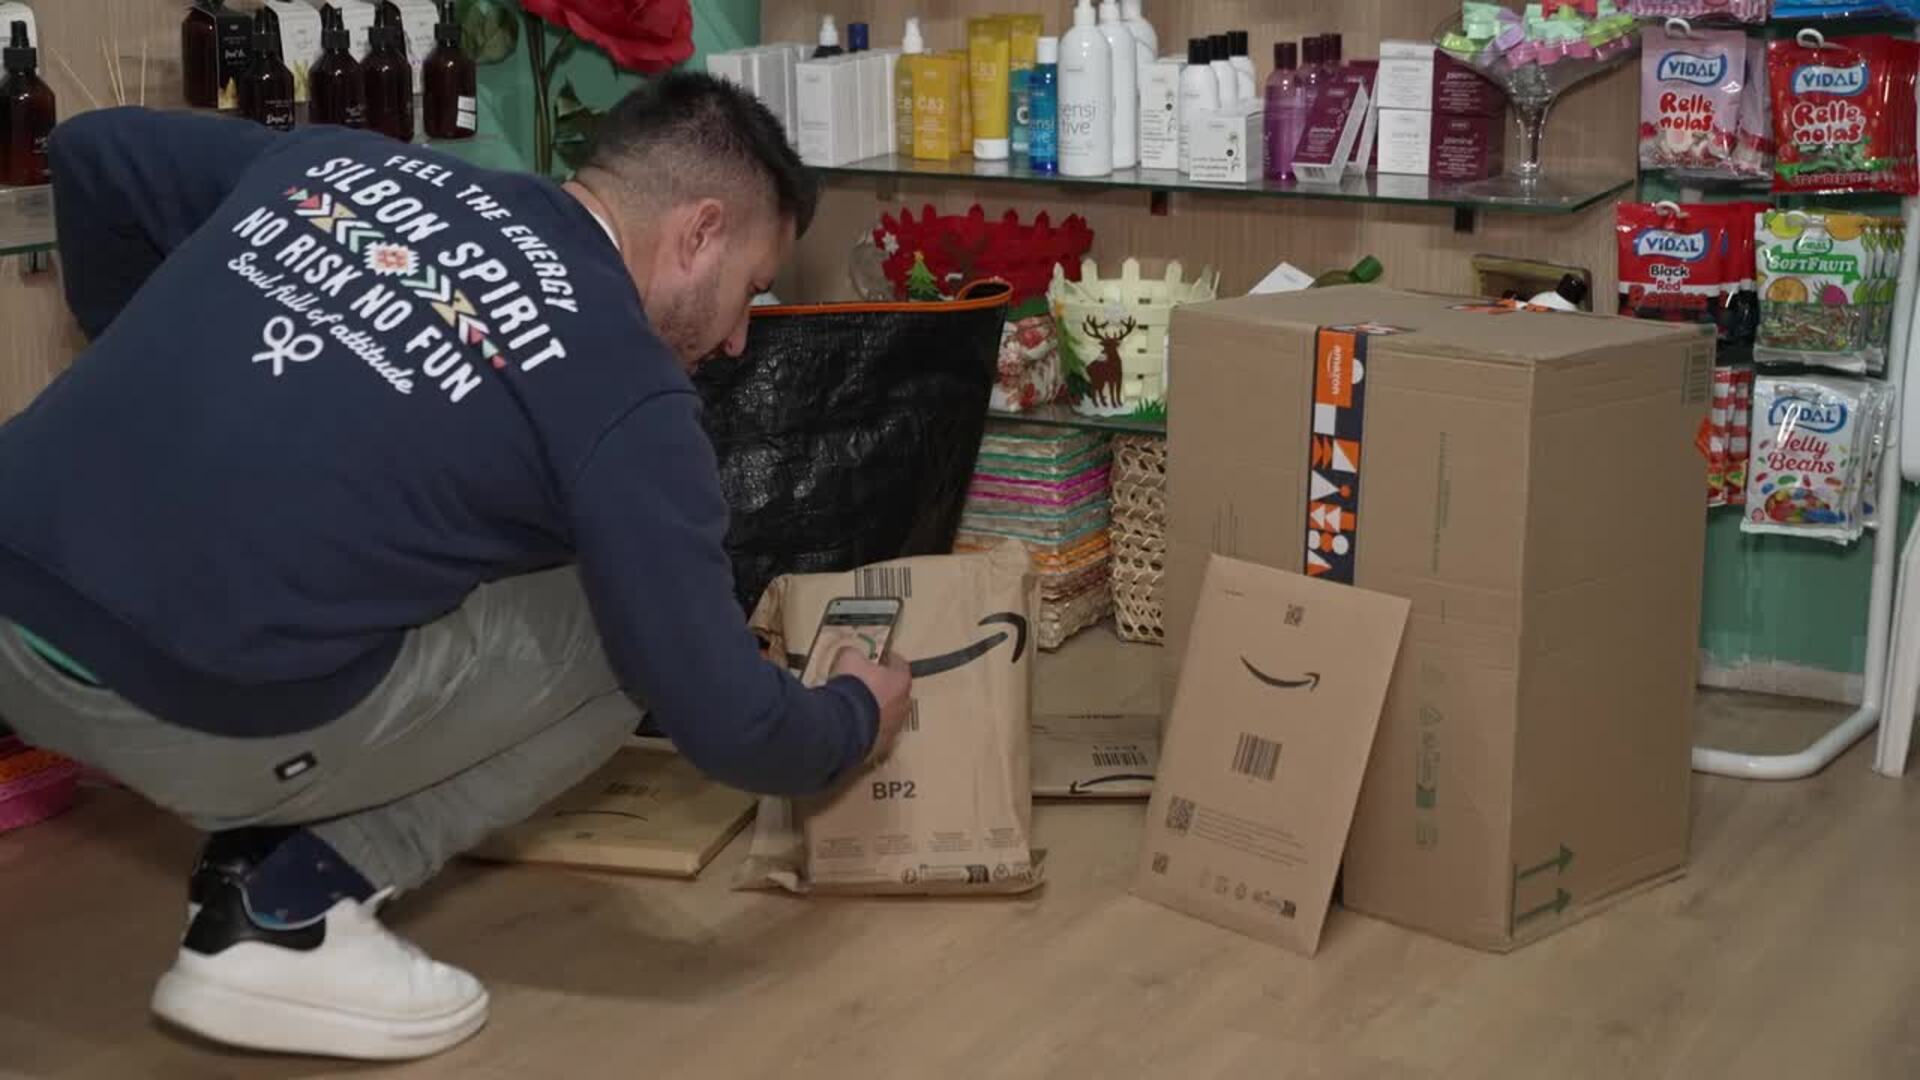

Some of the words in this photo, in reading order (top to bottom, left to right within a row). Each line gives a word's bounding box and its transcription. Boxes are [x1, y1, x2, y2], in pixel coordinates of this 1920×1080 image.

[1668, 61, 1717, 78] VIDAL
[1802, 72, 1858, 87] VIDAL
[1660, 92, 1713, 114] Relle
[1794, 101, 1860, 127] Relle
[1660, 112, 1713, 132] nolas
[1794, 123, 1861, 144] nolas
[384, 155, 453, 188] FEEL
[456, 184, 512, 221] THE
[501, 225, 578, 313] ENERGY
[1646, 237, 1700, 252] VIDAL
[305, 157, 450, 242] SILBON
[437, 241, 567, 371] SPIRIT
[1650, 264, 1689, 277] Black
[1657, 280, 1681, 291] Red
[232, 207, 289, 247] NO
[275, 234, 363, 297] RISK
[349, 283, 413, 331] NO
[405, 325, 482, 402] FUN
[227, 252, 285, 289] Soul
[264, 284, 320, 312] full
[306, 308, 344, 327] of
[329, 324, 415, 394] attitude
[1331, 344, 1342, 396] amazon
[1782, 430, 1830, 460] Jelly
[1768, 452, 1835, 474] Beans
[872, 780, 918, 800] BP2
